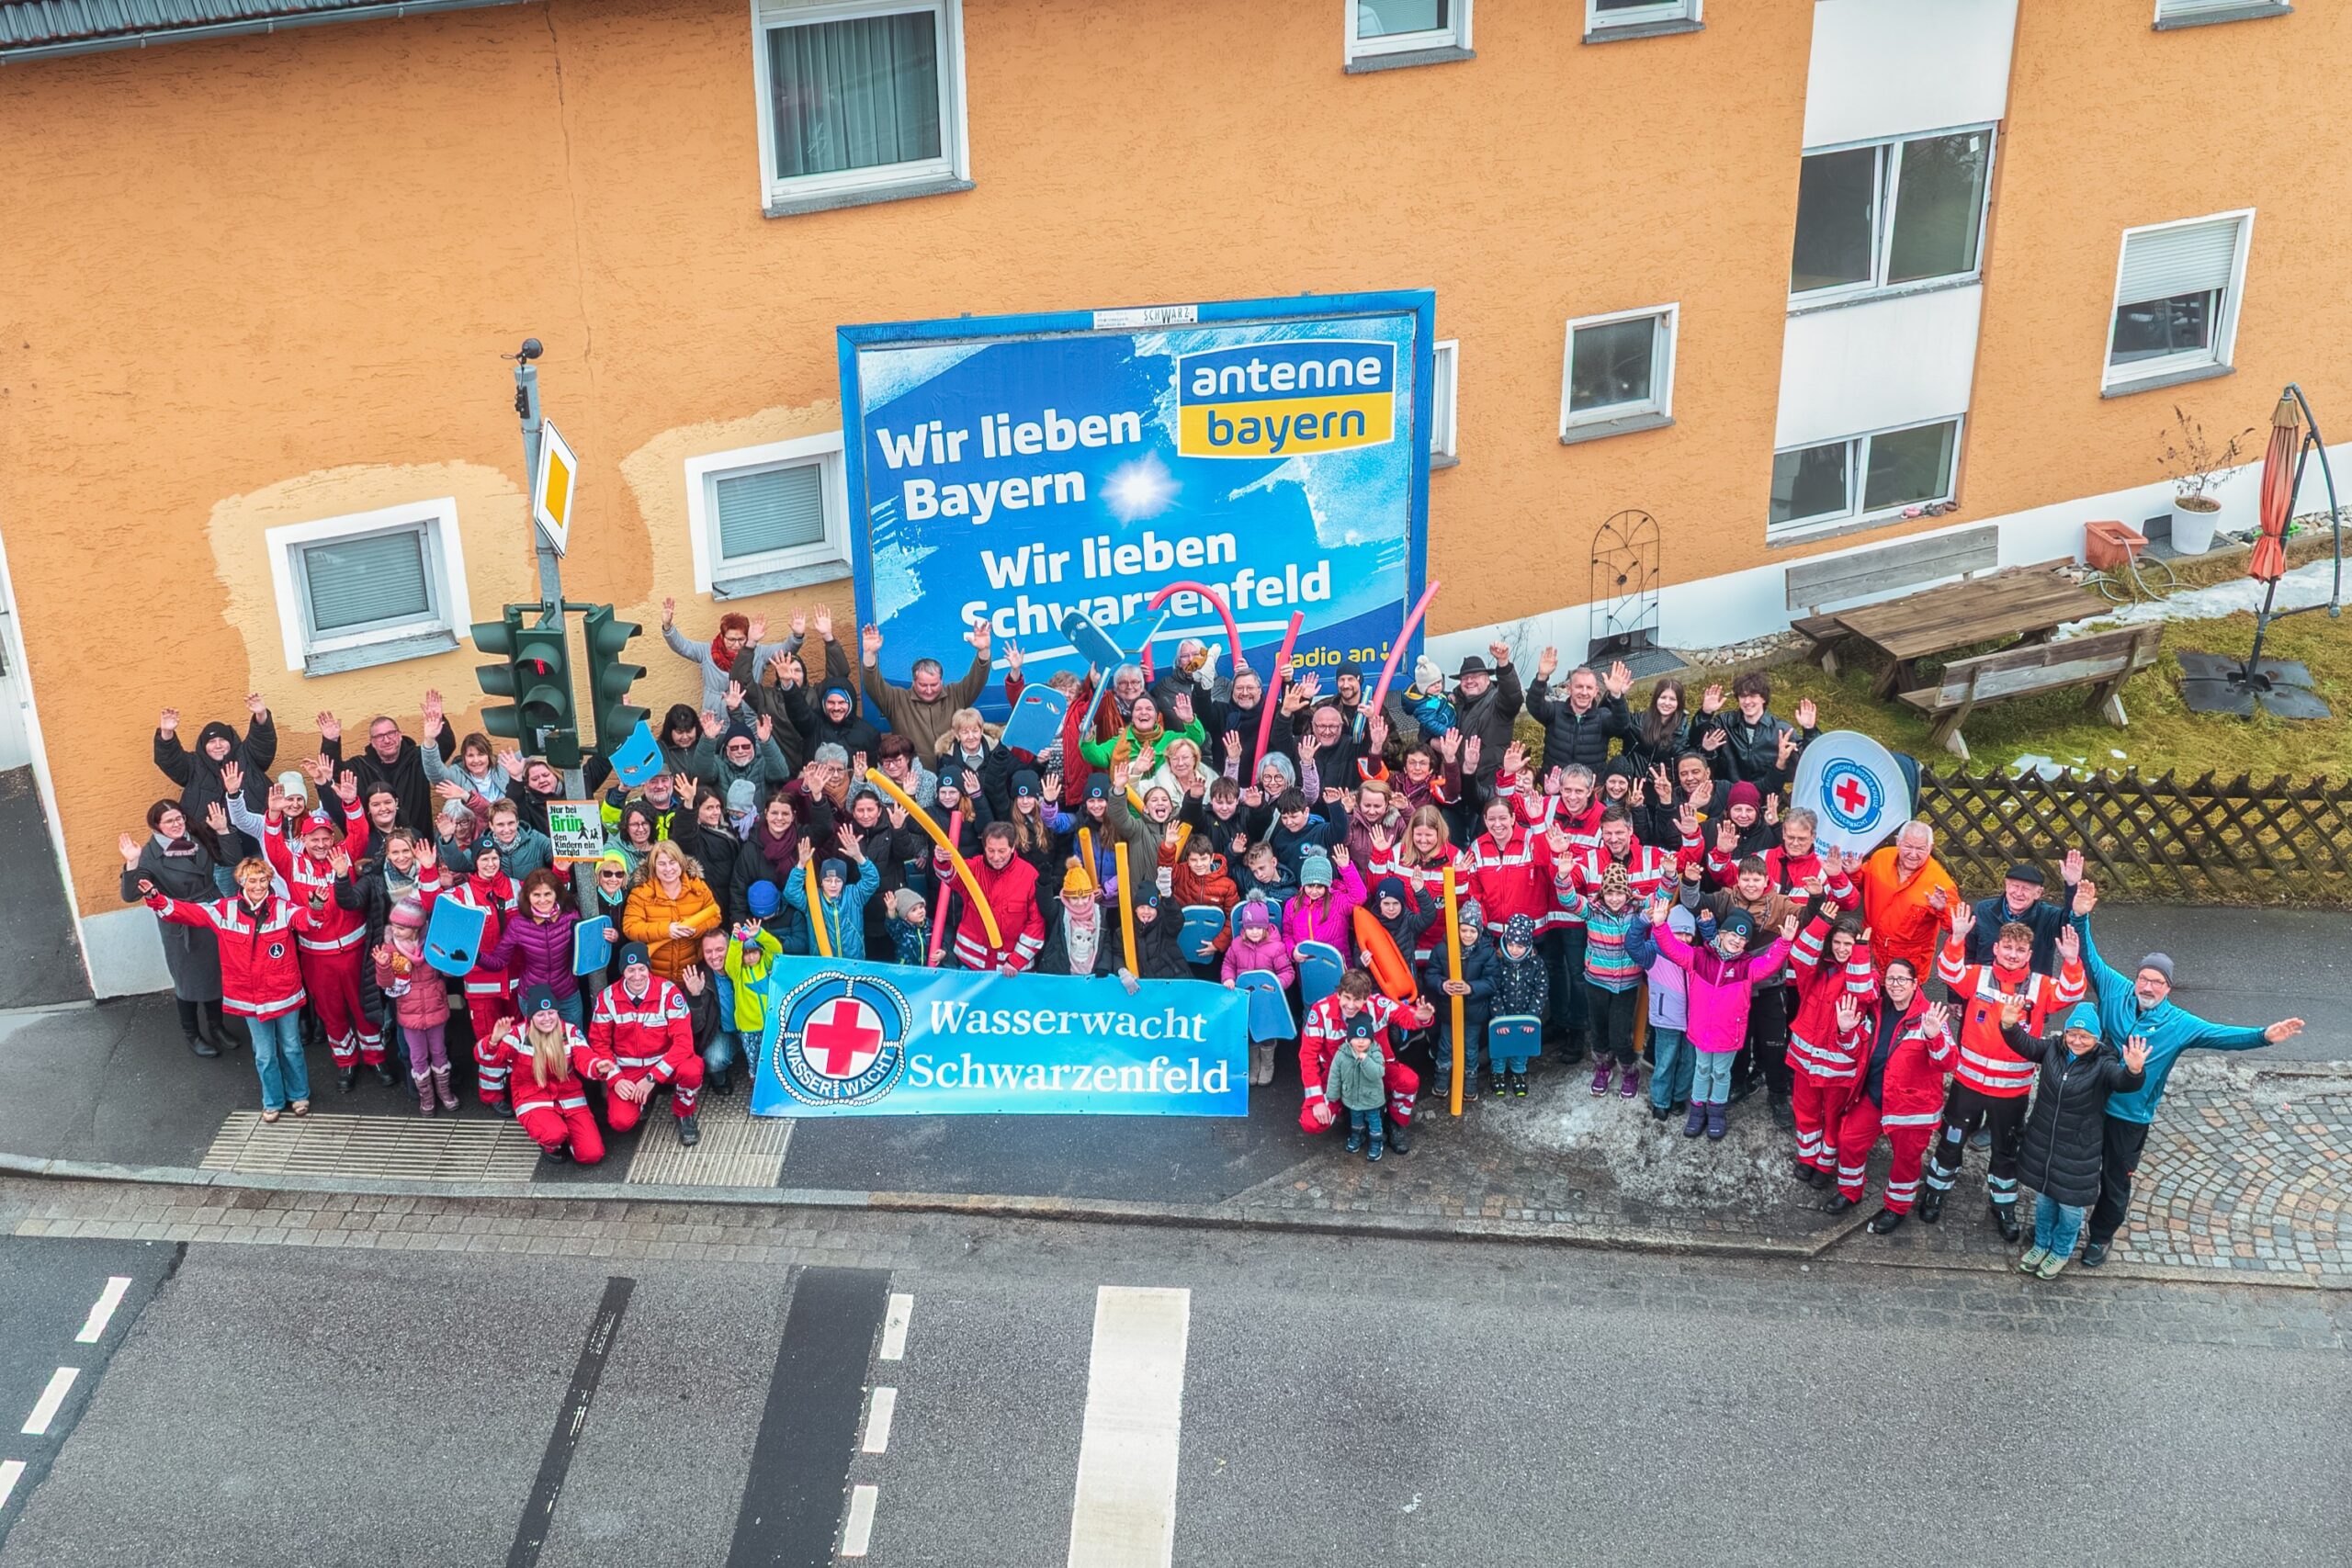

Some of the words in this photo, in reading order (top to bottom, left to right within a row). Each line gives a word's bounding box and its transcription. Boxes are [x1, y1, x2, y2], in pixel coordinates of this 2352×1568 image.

[1144, 307, 1190, 323] SCHWARZ
[1192, 356, 1382, 397] antenne
[876, 420, 969, 469] Wir
[980, 409, 1141, 458] lieben
[1207, 410, 1365, 454] bayern
[903, 470, 1086, 525] Bayern
[980, 543, 1070, 589] Wir
[1082, 531, 1237, 579] lieben
[1275, 646, 1341, 669] adio
[550, 806, 563, 814] Nur
[565, 805, 577, 814] bei
[551, 815, 582, 832] Grün
[553, 833, 567, 841] den
[554, 840, 582, 849] Kindern
[931, 1000, 1207, 1043] Wasserwacht
[786, 1038, 833, 1096] WASSER
[842, 1050, 894, 1096] WACHT
[908, 1053, 1231, 1094] Schwarzenfeld
